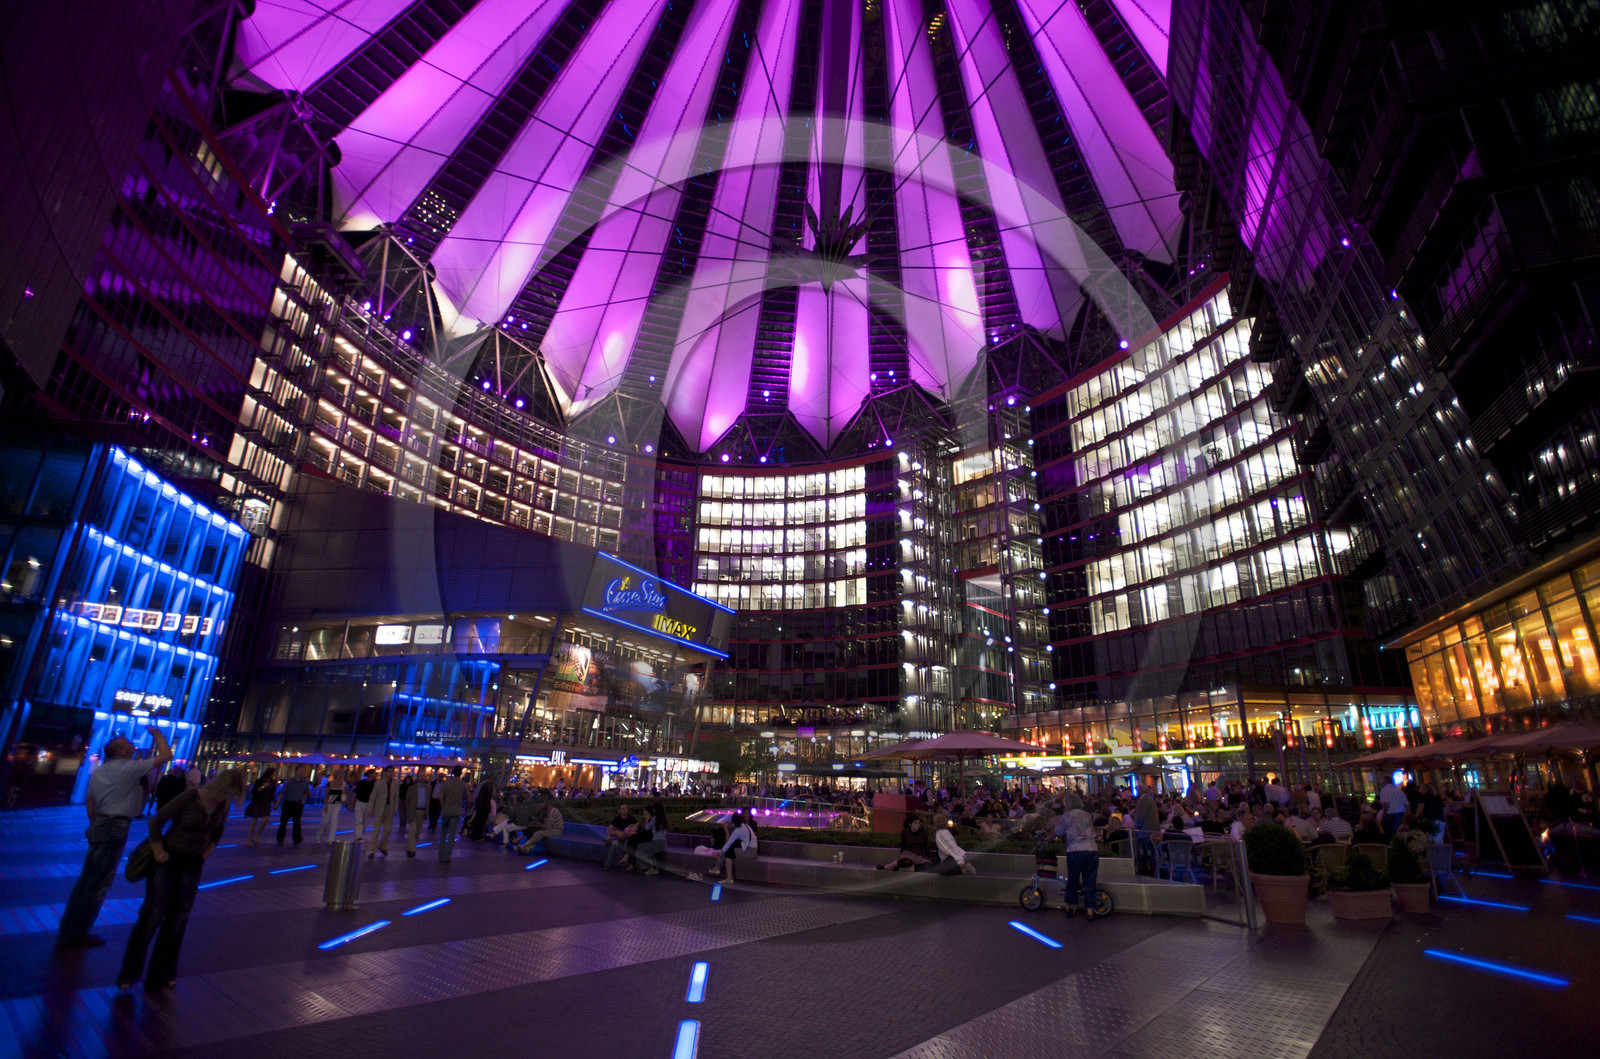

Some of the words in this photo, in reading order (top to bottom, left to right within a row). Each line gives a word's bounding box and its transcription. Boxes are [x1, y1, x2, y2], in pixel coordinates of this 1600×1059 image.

[654, 614, 693, 640] IMAX
[115, 691, 145, 709] sony
[144, 695, 173, 711] style
